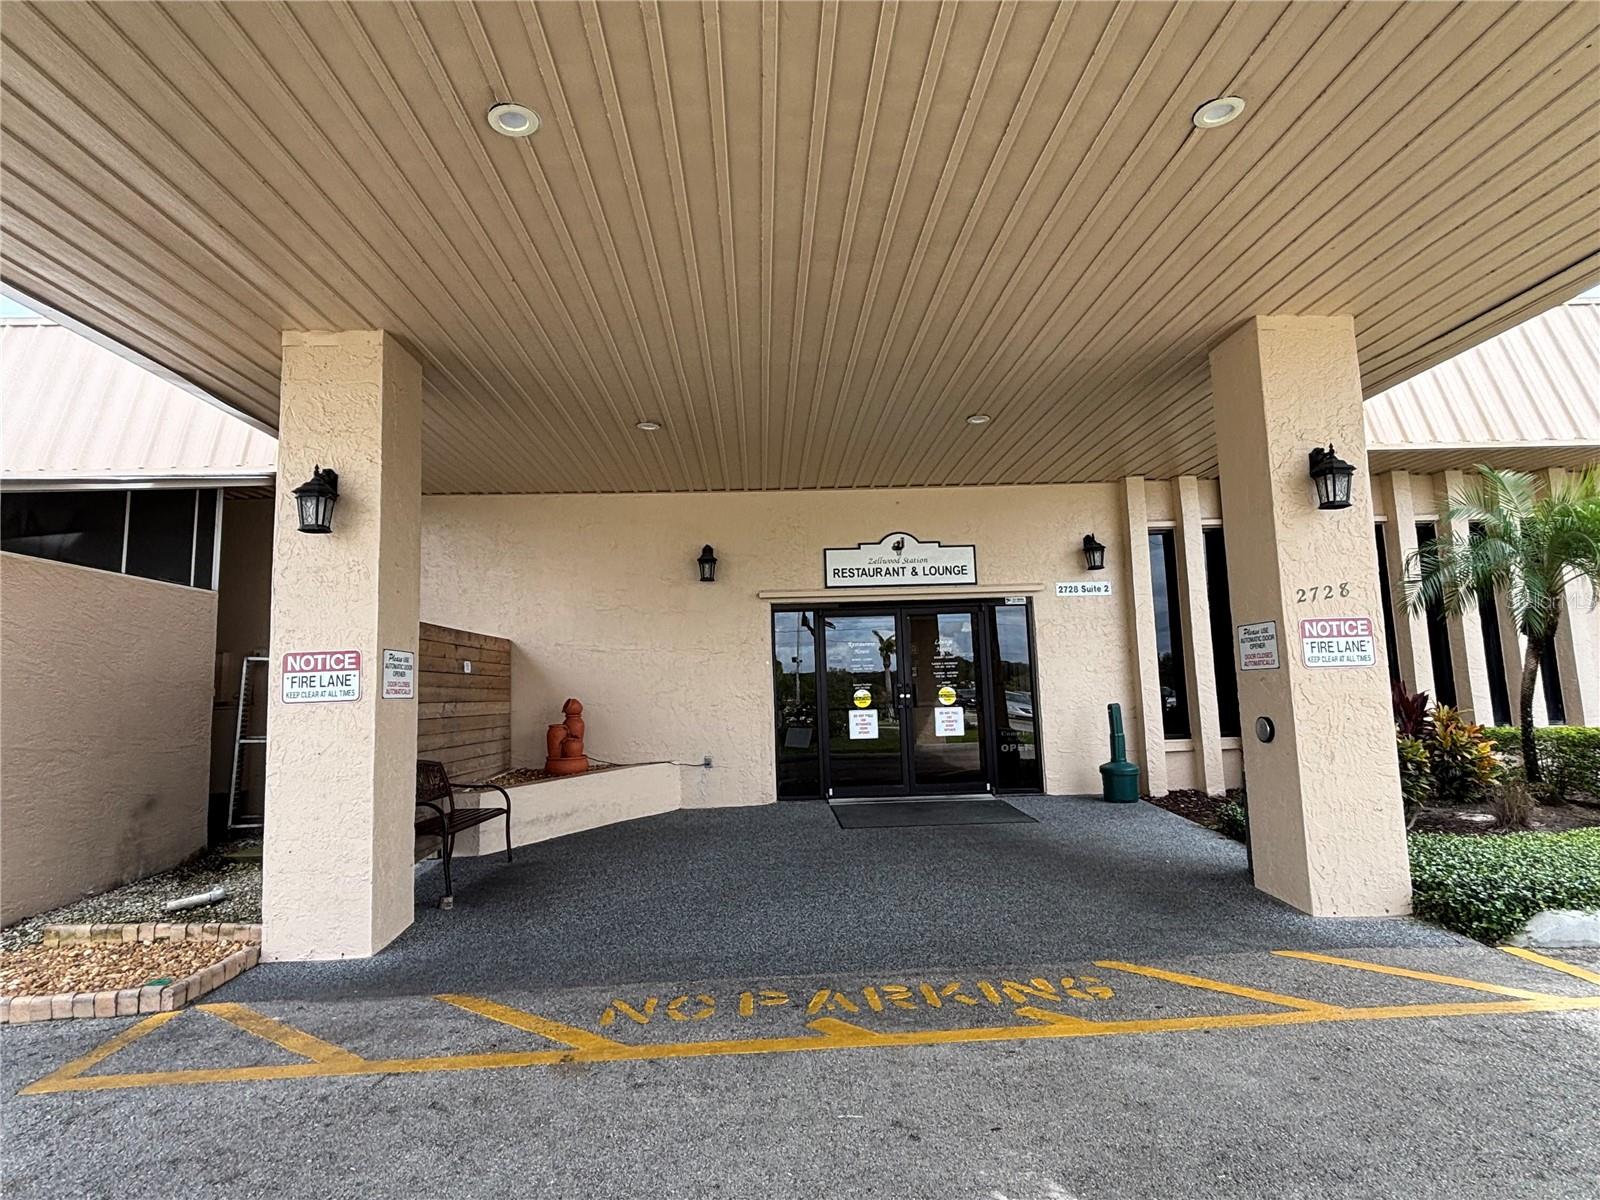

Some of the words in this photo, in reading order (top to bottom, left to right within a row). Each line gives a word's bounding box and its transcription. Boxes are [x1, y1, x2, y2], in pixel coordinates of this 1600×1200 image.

[868, 556, 900, 565] Zellwood
[902, 556, 928, 564] Station
[833, 566, 906, 578] RESTAURANT
[911, 565, 918, 576] &
[923, 565, 968, 576] LOUNGE
[1058, 585, 1079, 594] 2728
[1081, 585, 1101, 593] Suite
[1104, 584, 1110, 593] 2
[1296, 581, 1350, 603] 2728
[1304, 620, 1369, 637] NOTICE
[287, 653, 357, 671] NOTICE
[1307, 656, 1321, 664] KEEP
[1322, 655, 1338, 663] CLEAR
[1357, 654, 1371, 662] TIMES
[286, 691, 300, 699] KEEP
[301, 690, 319, 698] CLEAR
[339, 689, 355, 697] TIMES
[598, 993, 716, 1027] NO
[738, 975, 1115, 1019] PARKING
